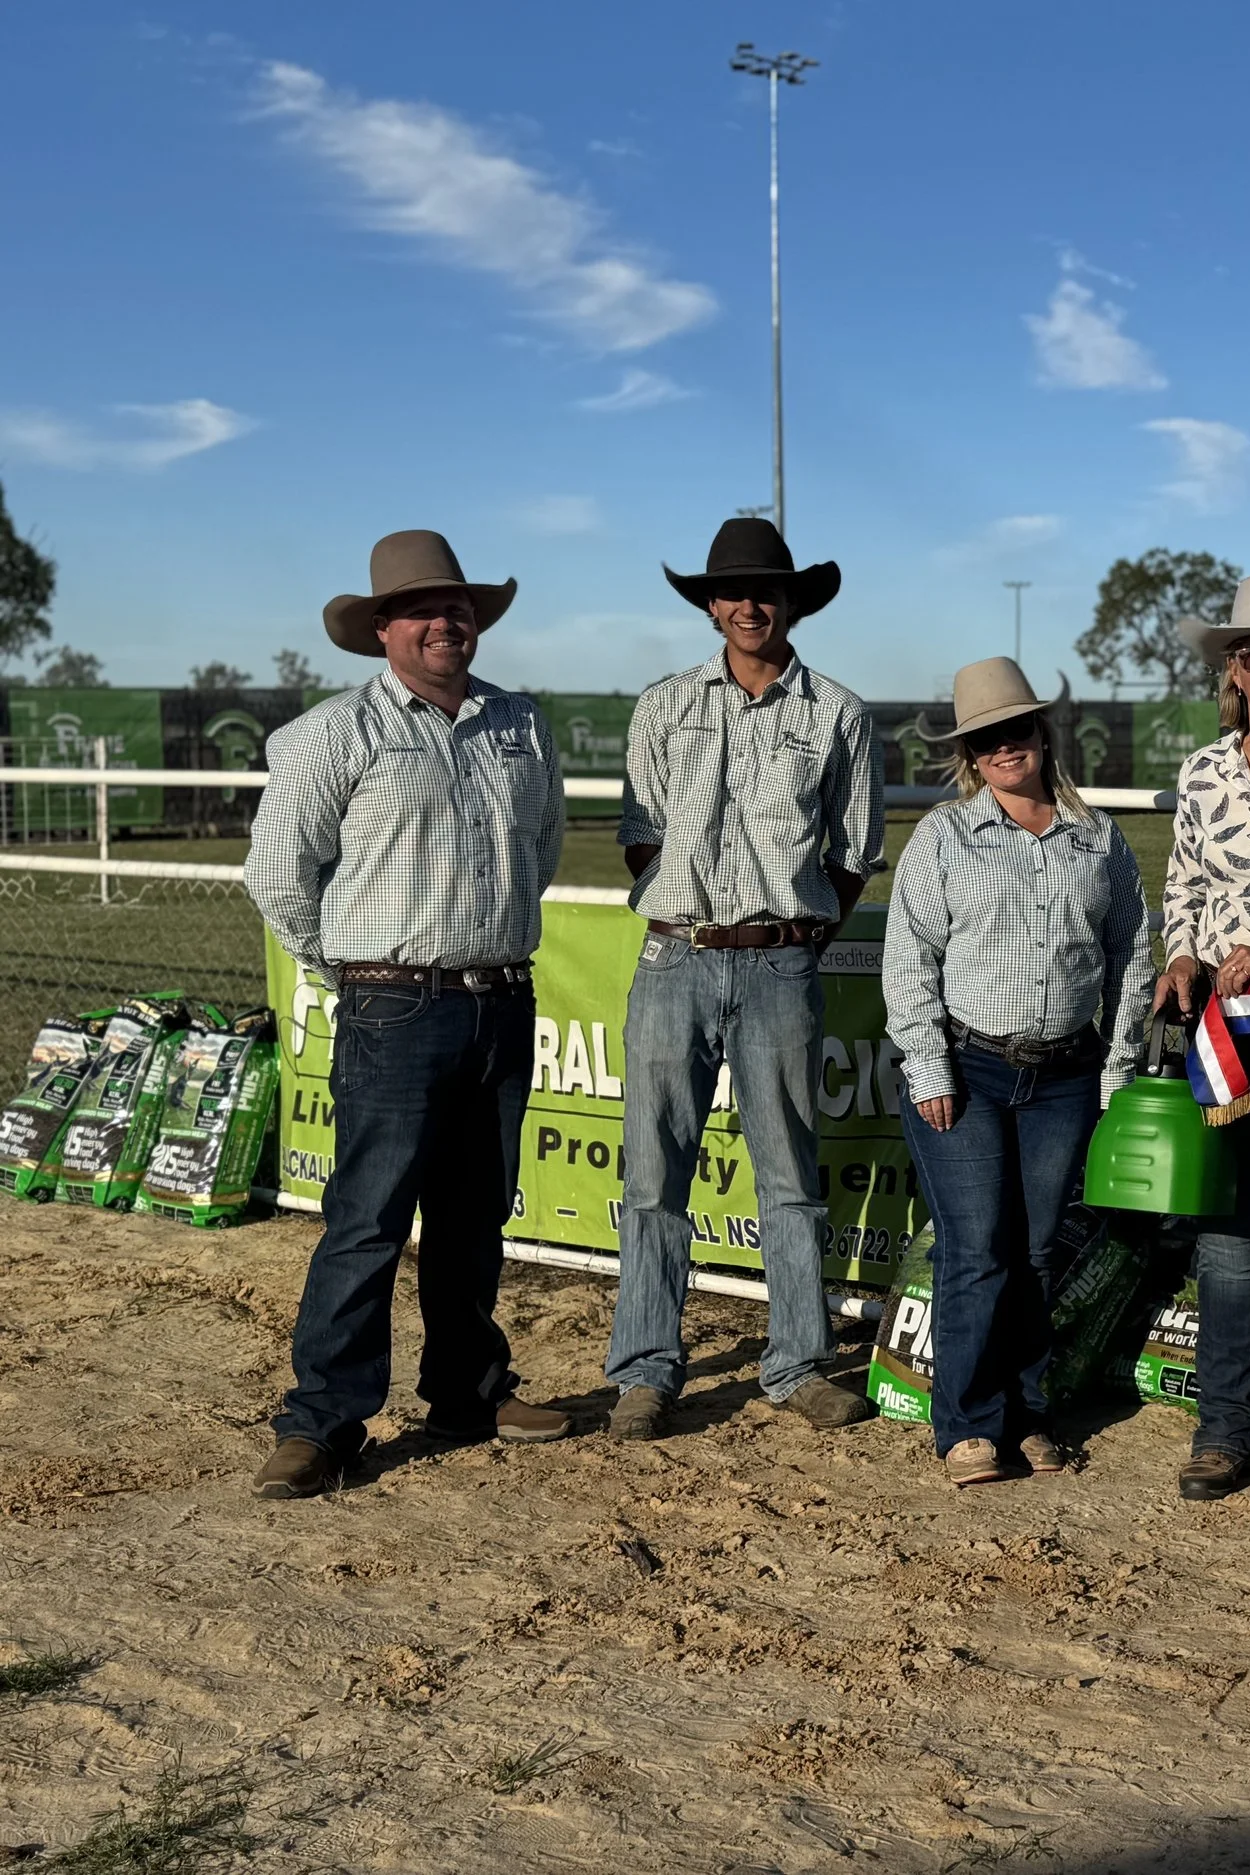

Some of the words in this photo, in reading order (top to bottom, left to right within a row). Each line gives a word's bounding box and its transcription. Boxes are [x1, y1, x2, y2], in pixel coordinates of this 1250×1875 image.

[726, 1214, 763, 1250] NS
[837, 1223, 891, 1266] 6722
[1148, 1329, 1163, 1342] or
[1163, 1332, 1198, 1348] work
[912, 1357, 927, 1375] for
[876, 1381, 911, 1413] Plus
